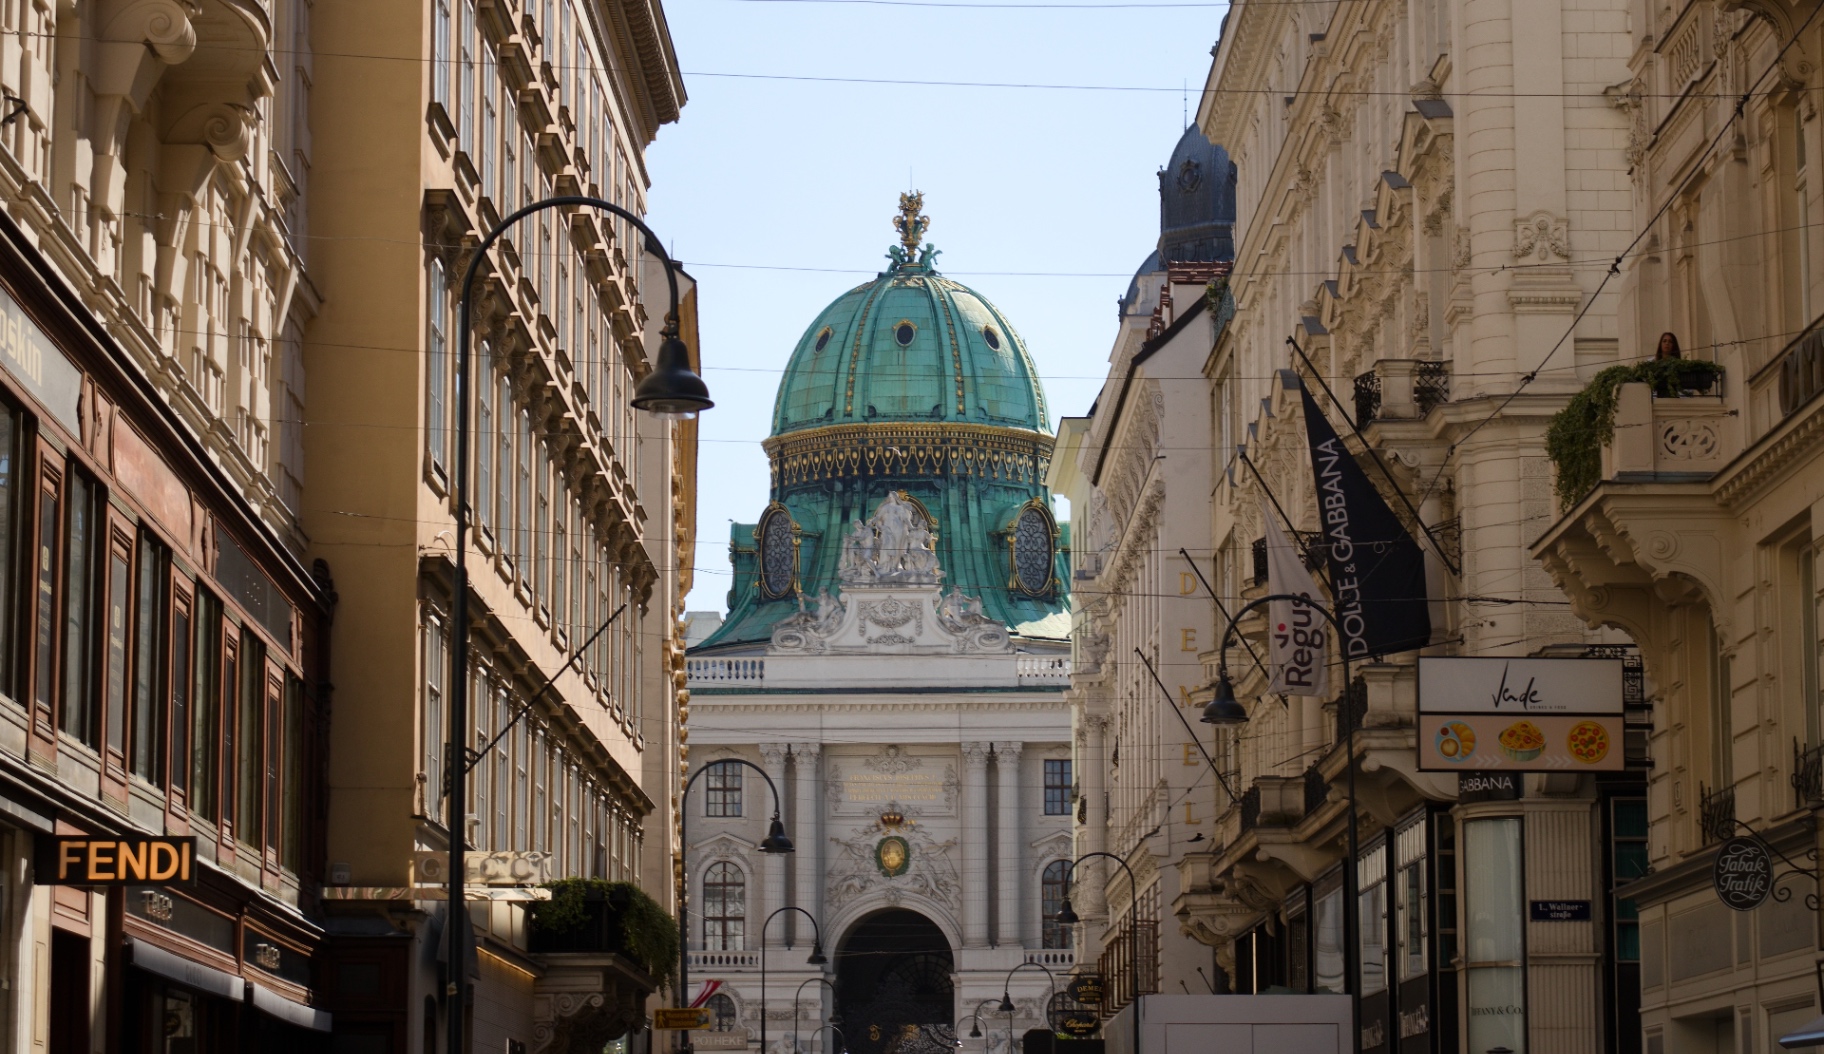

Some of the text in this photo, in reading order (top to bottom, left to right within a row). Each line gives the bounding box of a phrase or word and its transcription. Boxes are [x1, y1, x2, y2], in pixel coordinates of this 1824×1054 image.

[1316, 437, 1368, 657] DOLCE & GABBANA
[1285, 591, 1324, 687] Regus
[58, 841, 190, 881] FENDI
[420, 857, 547, 881] GCCI
[1719, 850, 1767, 874] Tabak
[1719, 873, 1767, 896] Trafik
[1077, 985, 1103, 993] DEMEL
[1496, 1006, 1504, 1015] &
[693, 1036, 744, 1046] POTHEKE
